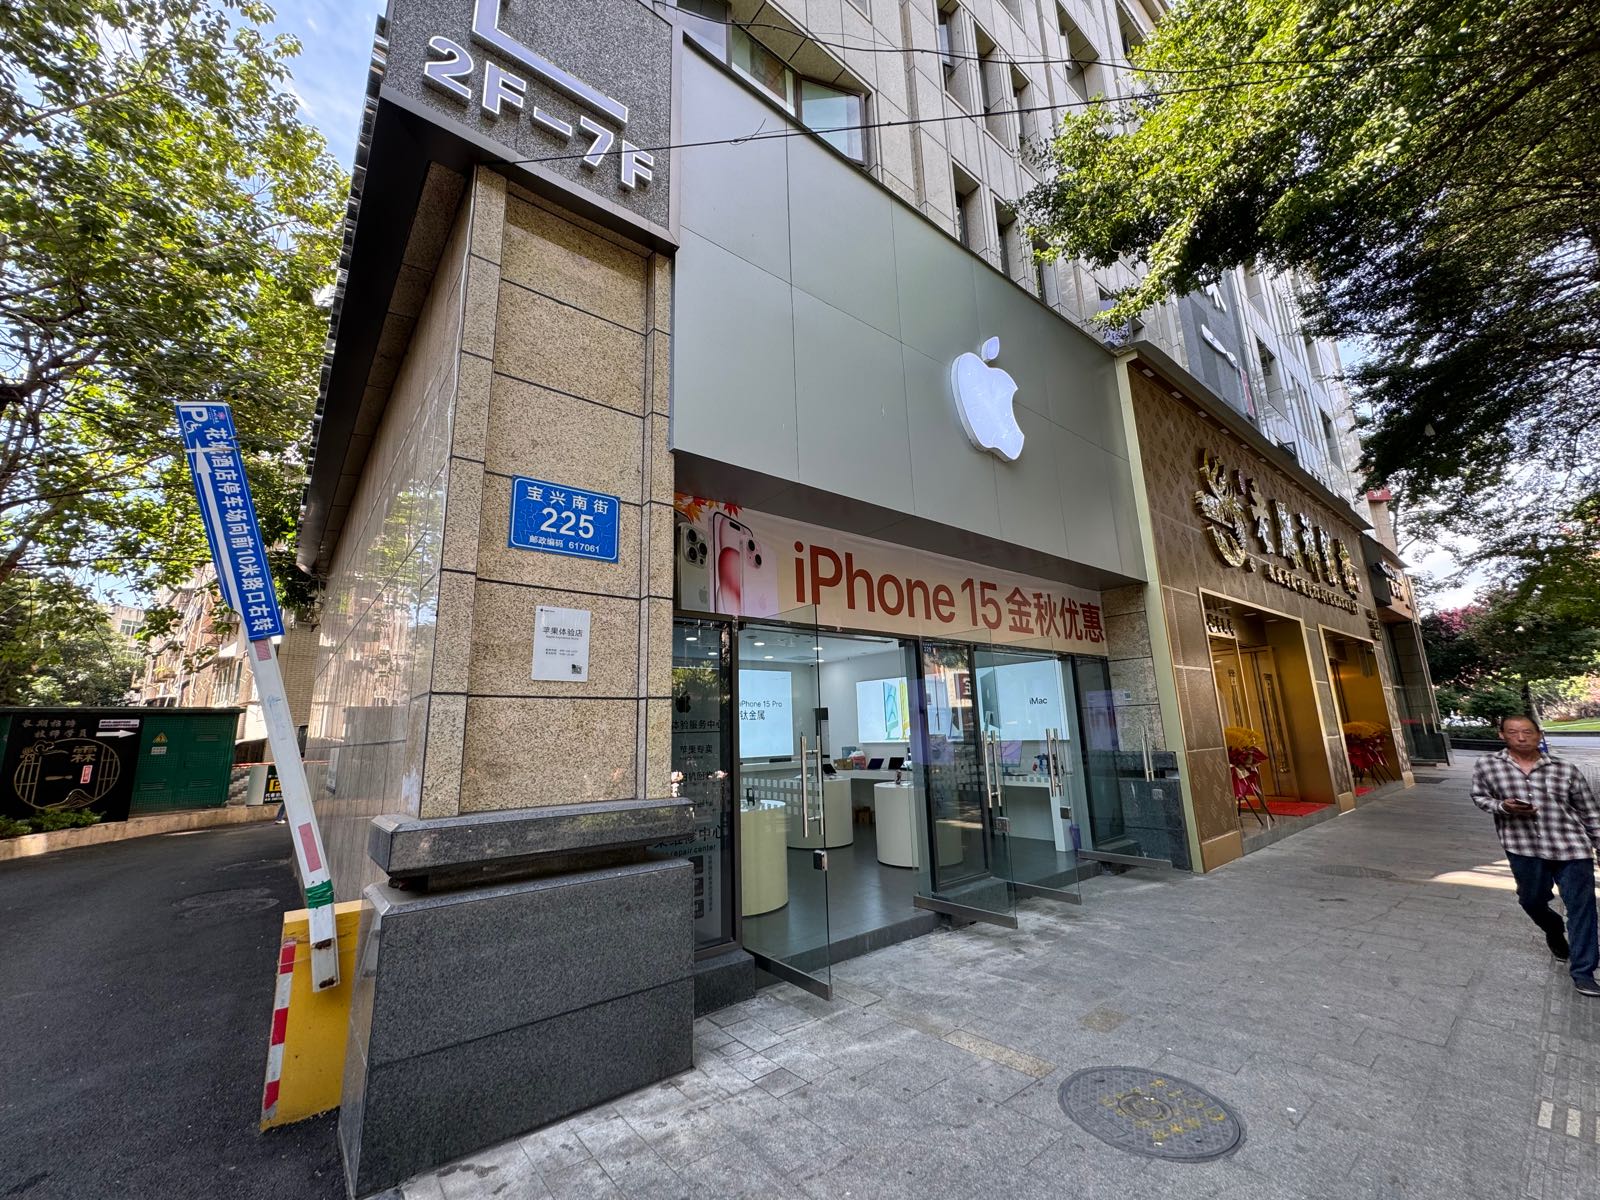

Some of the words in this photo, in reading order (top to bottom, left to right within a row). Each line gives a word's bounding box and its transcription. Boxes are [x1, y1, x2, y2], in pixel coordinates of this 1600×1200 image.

[181, 407, 209, 422] P
[526, 486, 608, 515] 宝兴南街
[540, 508, 594, 539] 225
[529, 535, 563, 548] 邮政编码
[568, 542, 600, 553] 617061
[793, 540, 956, 624] iPhone
[960, 577, 1003, 630] 15
[1005, 587, 1105, 644] 金秋优惠
[543, 627, 583, 637] 苹果体验店
[740, 700, 761, 708] iPhone
[1029, 697, 1048, 705] iMac
[740, 710, 766, 721] 钛金属
[671, 848, 692, 857] repair
[693, 844, 716, 854] center
